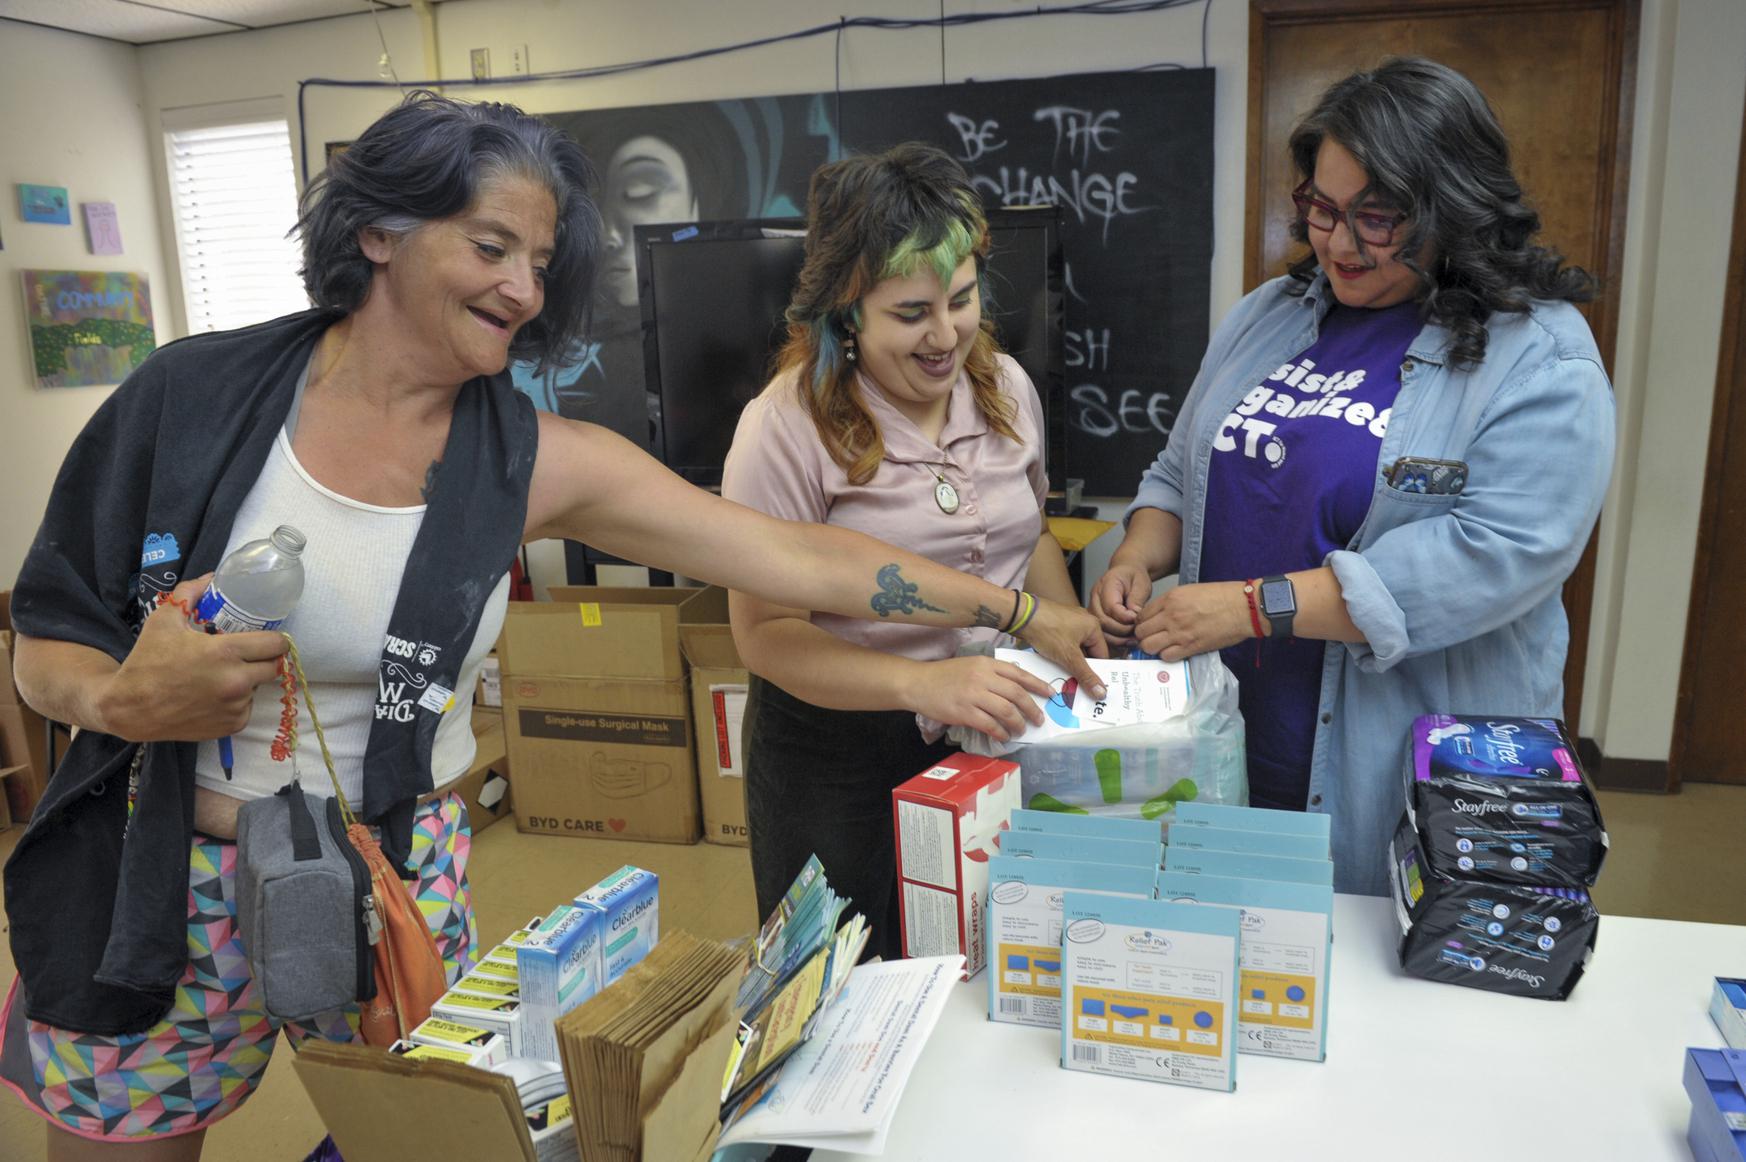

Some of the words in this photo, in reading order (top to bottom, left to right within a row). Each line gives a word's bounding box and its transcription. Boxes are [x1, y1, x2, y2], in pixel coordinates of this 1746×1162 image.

[947, 111, 1007, 162] BE
[1033, 106, 1121, 165] THE
[1065, 329, 1110, 371] SH
[1071, 384, 1174, 437] SEE
[544, 715, 596, 728] Single-use
[598, 718, 640, 731] Surgical
[642, 721, 669, 732] Mask
[1451, 798, 1508, 815] Stayfree
[529, 816, 559, 830] BYD
[564, 818, 604, 832] CARE
[611, 897, 654, 932] Clearblue
[1488, 964, 1546, 988] Stayfree
